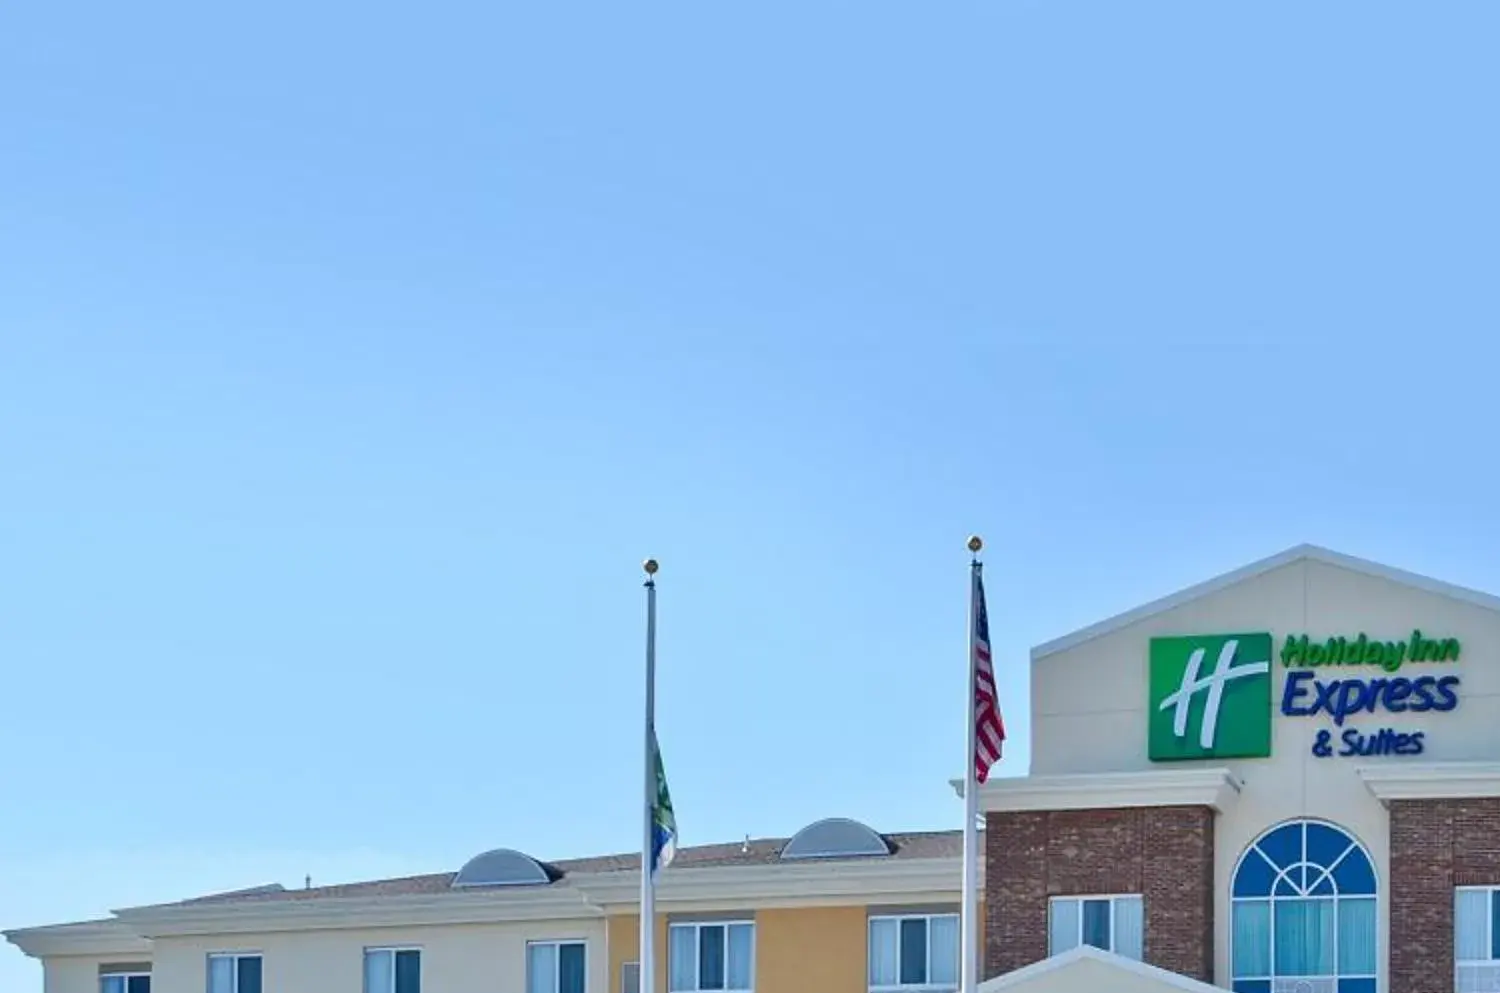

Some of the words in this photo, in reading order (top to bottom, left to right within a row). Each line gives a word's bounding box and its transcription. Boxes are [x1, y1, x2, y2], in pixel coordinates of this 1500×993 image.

[1280, 632, 1407, 672] Holiday
[1407, 629, 1460, 663] Inn
[1281, 671, 1460, 727] Express
[1312, 729, 1333, 757] &
[1339, 728, 1425, 757] Suites
